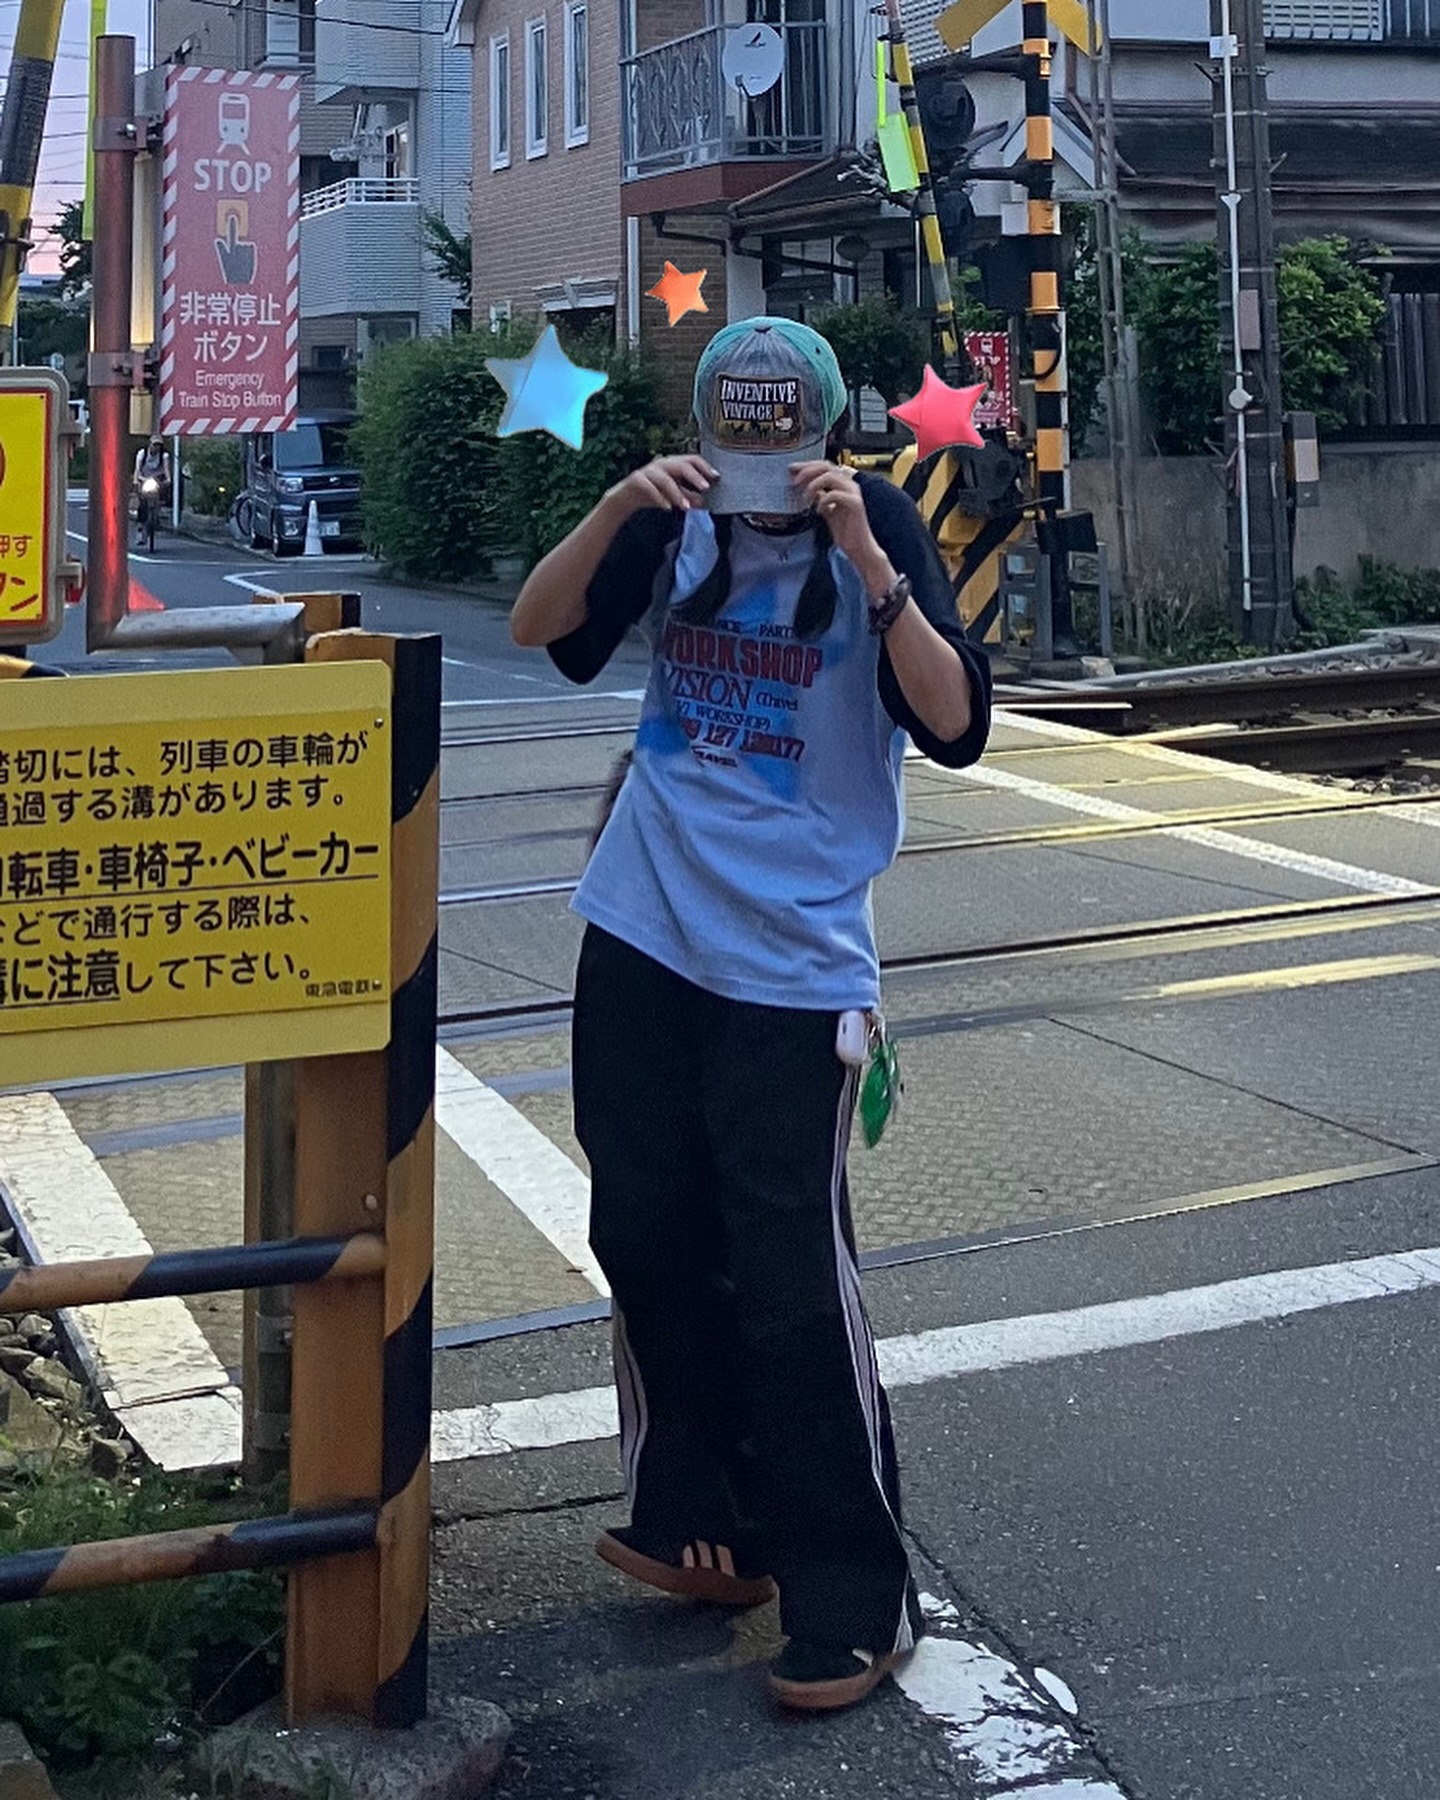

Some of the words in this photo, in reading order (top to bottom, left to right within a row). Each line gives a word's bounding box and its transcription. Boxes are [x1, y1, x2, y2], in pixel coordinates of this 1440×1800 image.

[193, 158, 273, 193] STOP
[179, 290, 282, 326] 非常停止
[193, 329, 268, 363] ボタン
[195, 369, 265, 390] Emergency
[720, 379, 797, 404] INVENTIVE
[179, 391, 209, 408] Train
[212, 390, 240, 410] Stop
[243, 390, 282, 407] Button
[723, 401, 774, 420] VINTAGE
[0, 573, 39, 612] ン
[0, 831, 379, 899] 転車・車椅子・ベビーカー
[0, 893, 310, 946] どで通行する際は、
[0, 950, 310, 1004] に注意して下さい。
